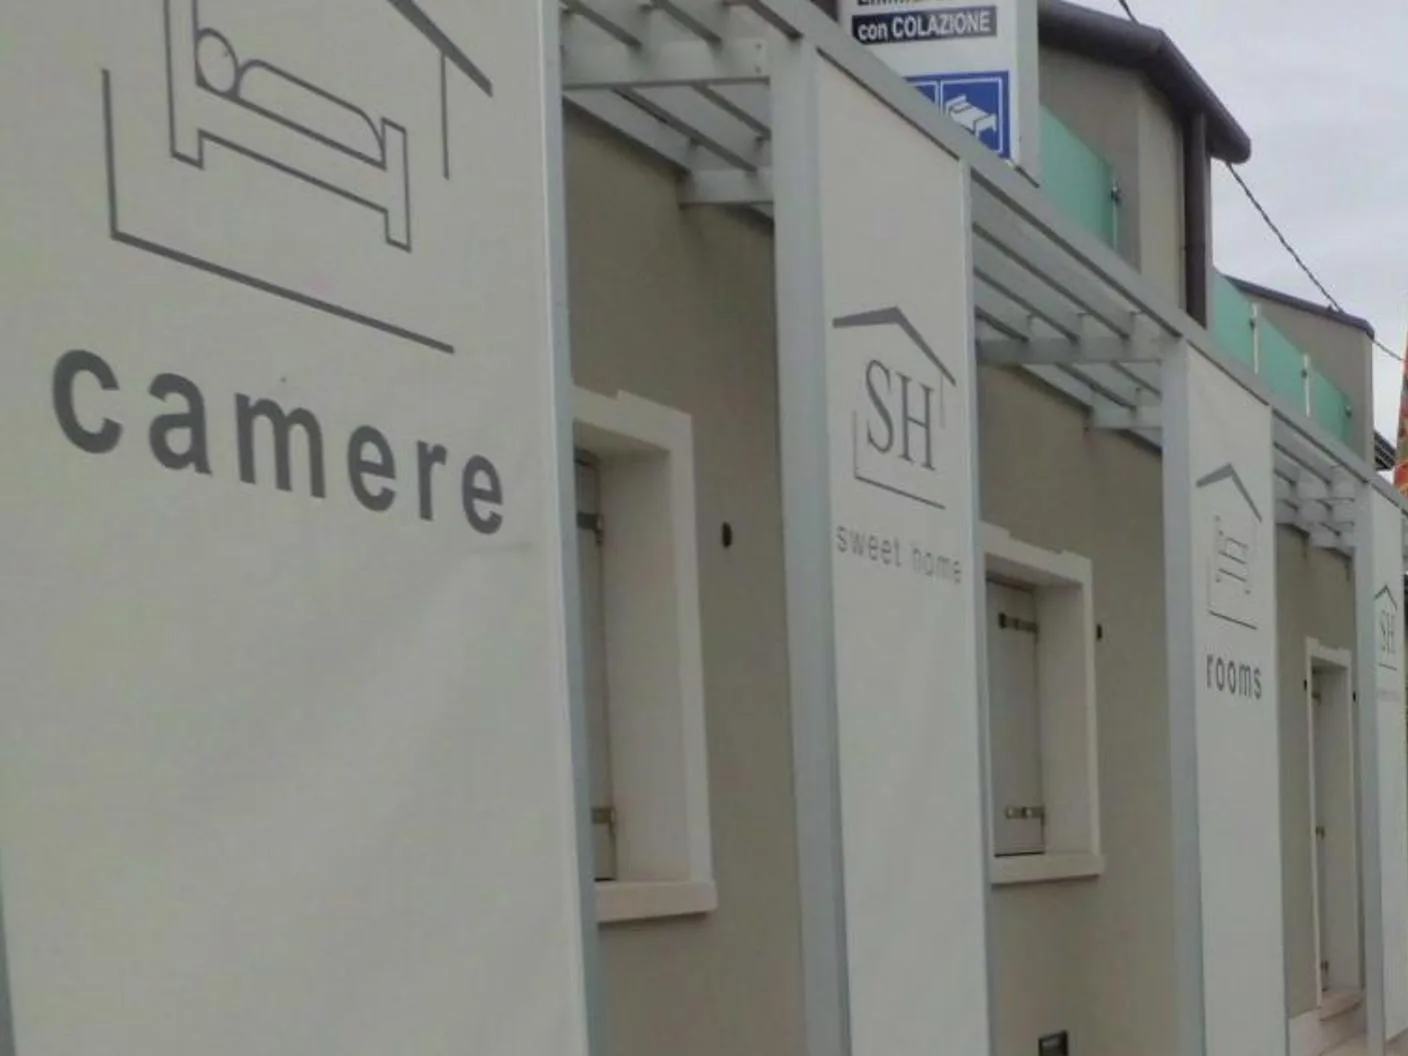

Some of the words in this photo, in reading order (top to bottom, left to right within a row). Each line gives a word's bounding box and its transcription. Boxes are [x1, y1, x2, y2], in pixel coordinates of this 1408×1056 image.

[857, 22, 889, 40] con
[892, 10, 991, 38] COLAZIONE
[52, 349, 505, 534] camere
[865, 359, 936, 472] SH
[836, 525, 902, 568] sweet
[911, 538, 962, 585] home
[1206, 654, 1262, 700] rooms
